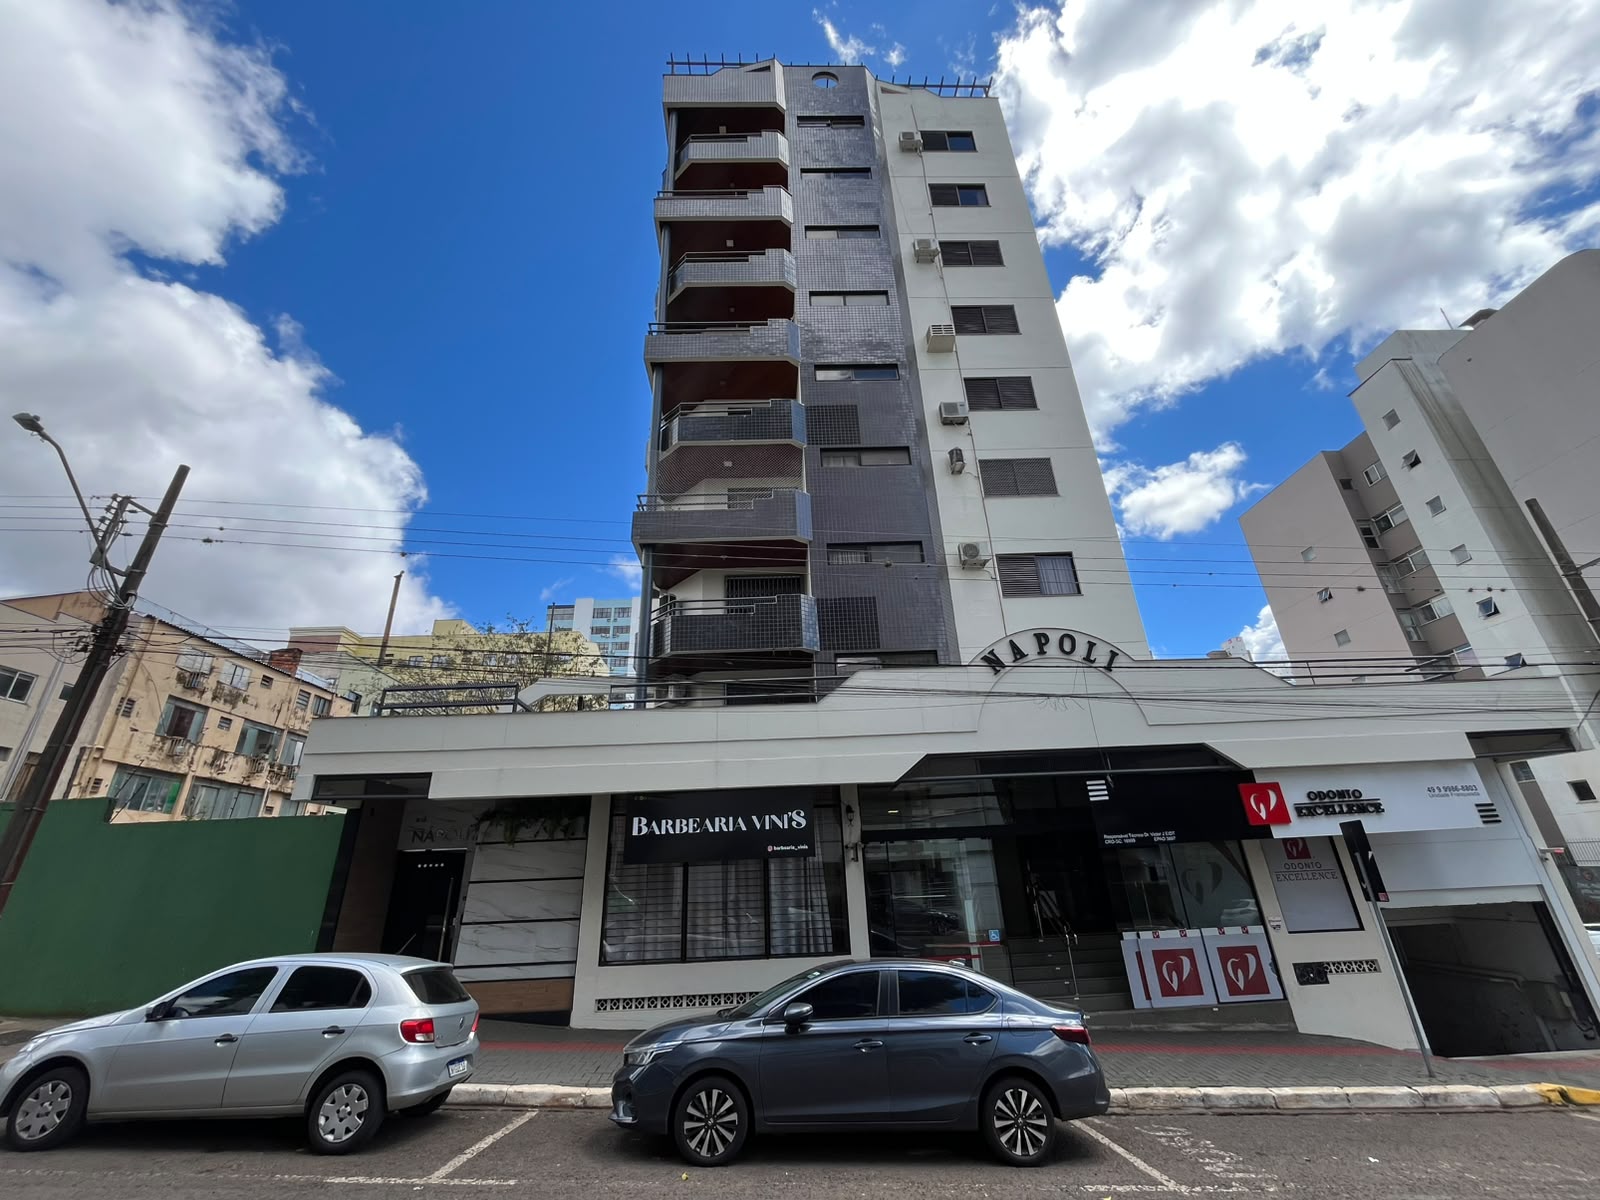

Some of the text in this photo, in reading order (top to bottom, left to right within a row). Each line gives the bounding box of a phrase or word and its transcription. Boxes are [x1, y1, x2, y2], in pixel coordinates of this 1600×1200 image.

[981, 632, 1119, 675] NAPOLI
[1306, 789, 1362, 801] ODONTO
[1294, 802, 1385, 817] EXCELLENCE
[632, 809, 807, 836] BARBEARIA VINI'S
[1284, 861, 1322, 870] ODONTO
[1275, 871, 1338, 882] EXCELLENCE
